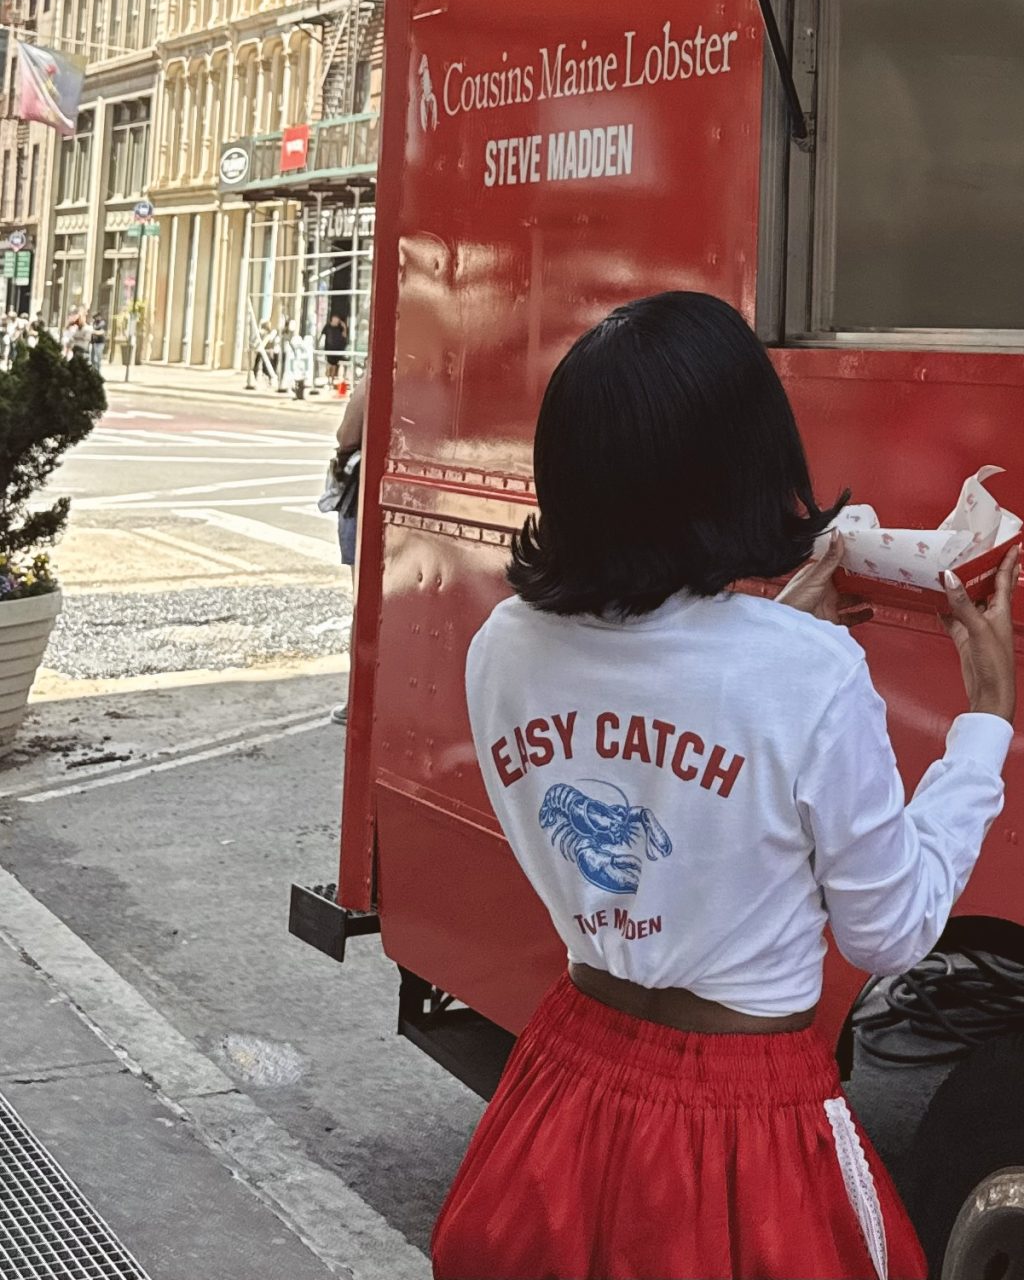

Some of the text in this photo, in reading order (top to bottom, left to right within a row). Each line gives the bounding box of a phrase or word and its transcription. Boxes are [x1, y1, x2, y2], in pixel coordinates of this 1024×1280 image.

[443, 20, 738, 116] Cousins Maine Lobster
[484, 123, 634, 187] STEVE MADDEN
[595, 711, 746, 799] CATCH
